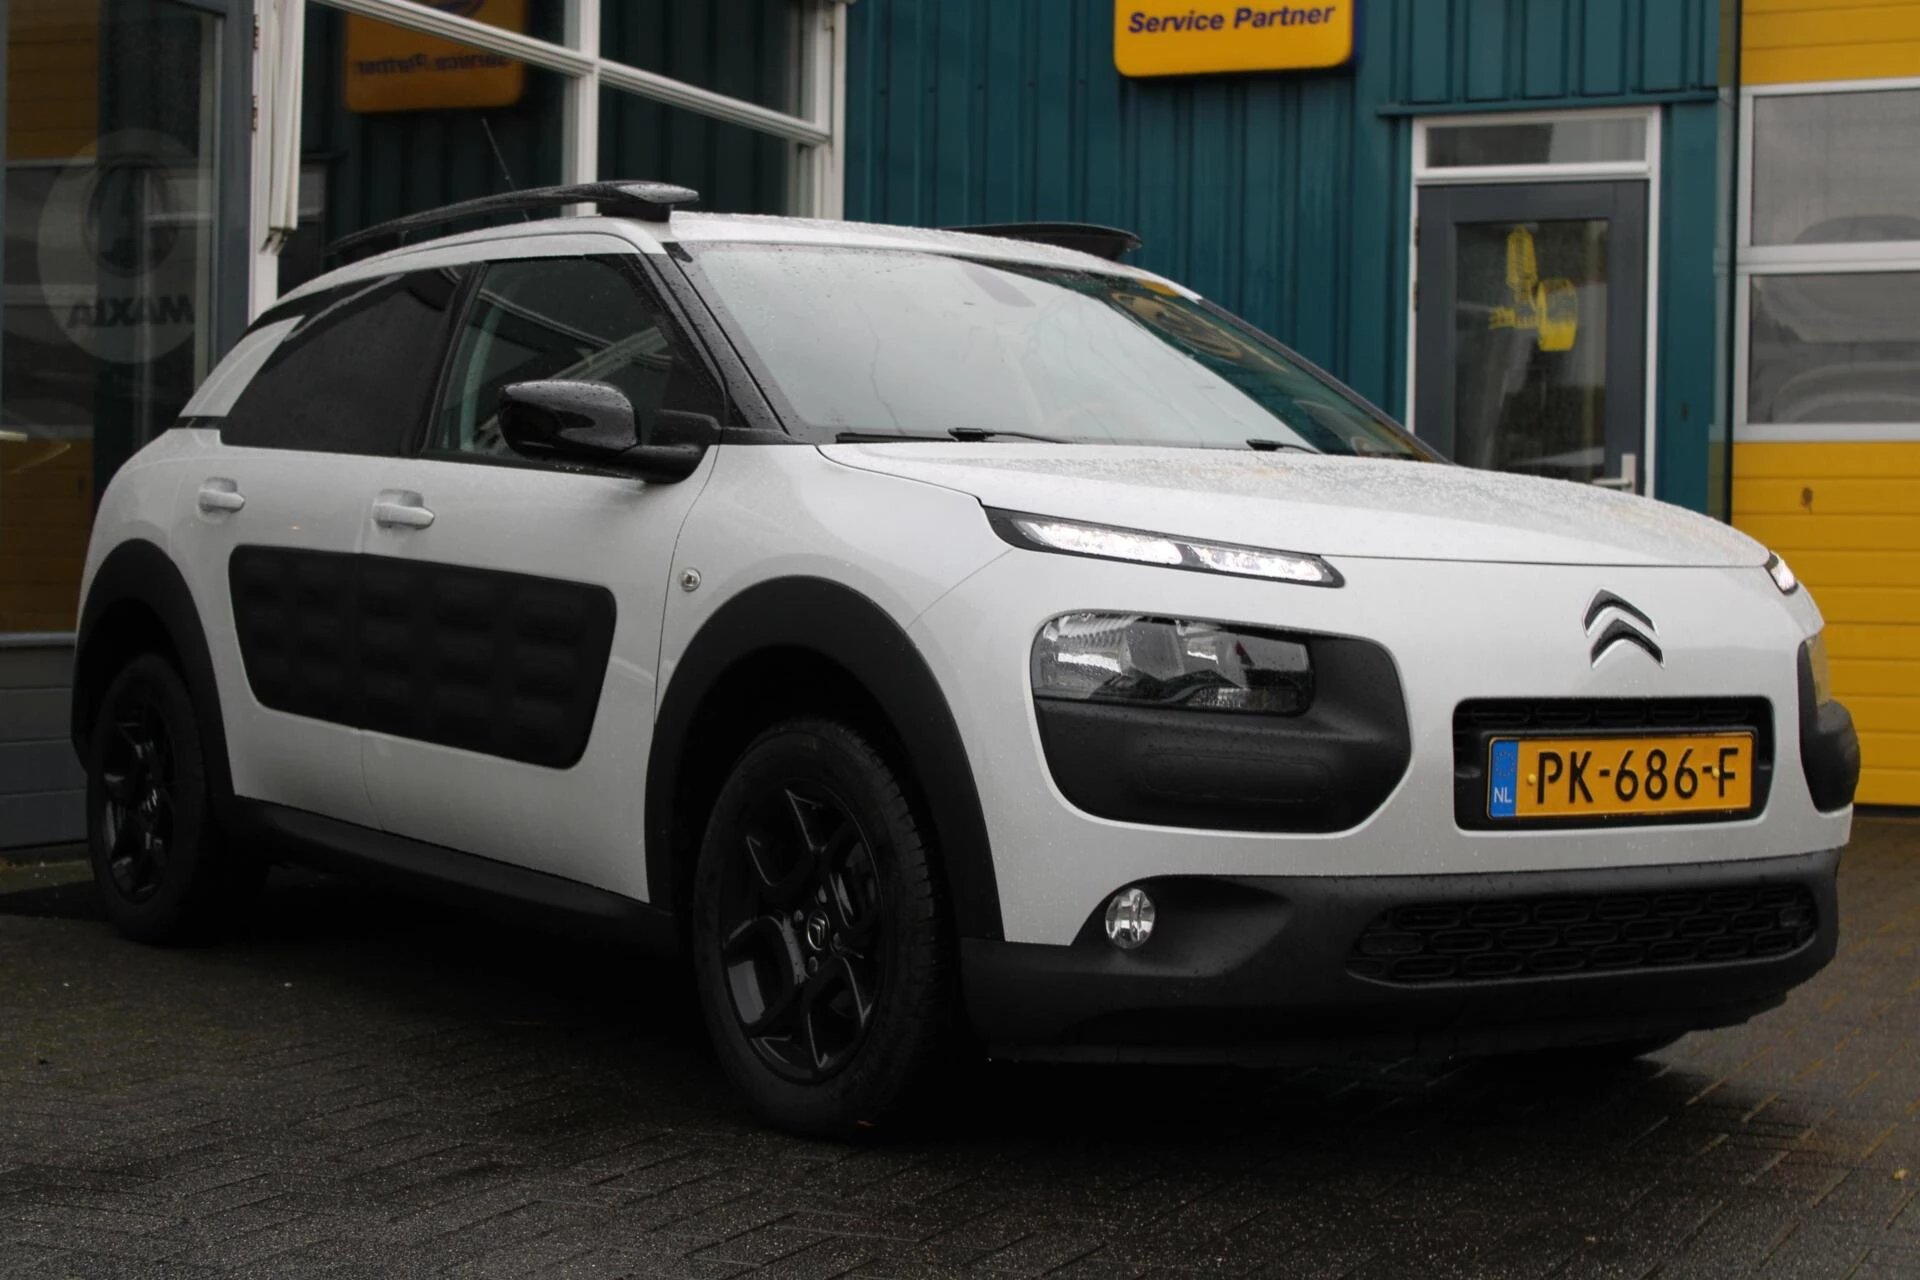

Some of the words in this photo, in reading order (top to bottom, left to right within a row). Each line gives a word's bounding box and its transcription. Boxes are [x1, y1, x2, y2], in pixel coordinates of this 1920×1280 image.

[1128, 10, 1225, 33] Service
[1234, 6, 1336, 29] Partner
[68, 294, 196, 328] AIXAM
[1537, 747, 1739, 804] PK-686-F
[1493, 787, 1513, 804] NL
